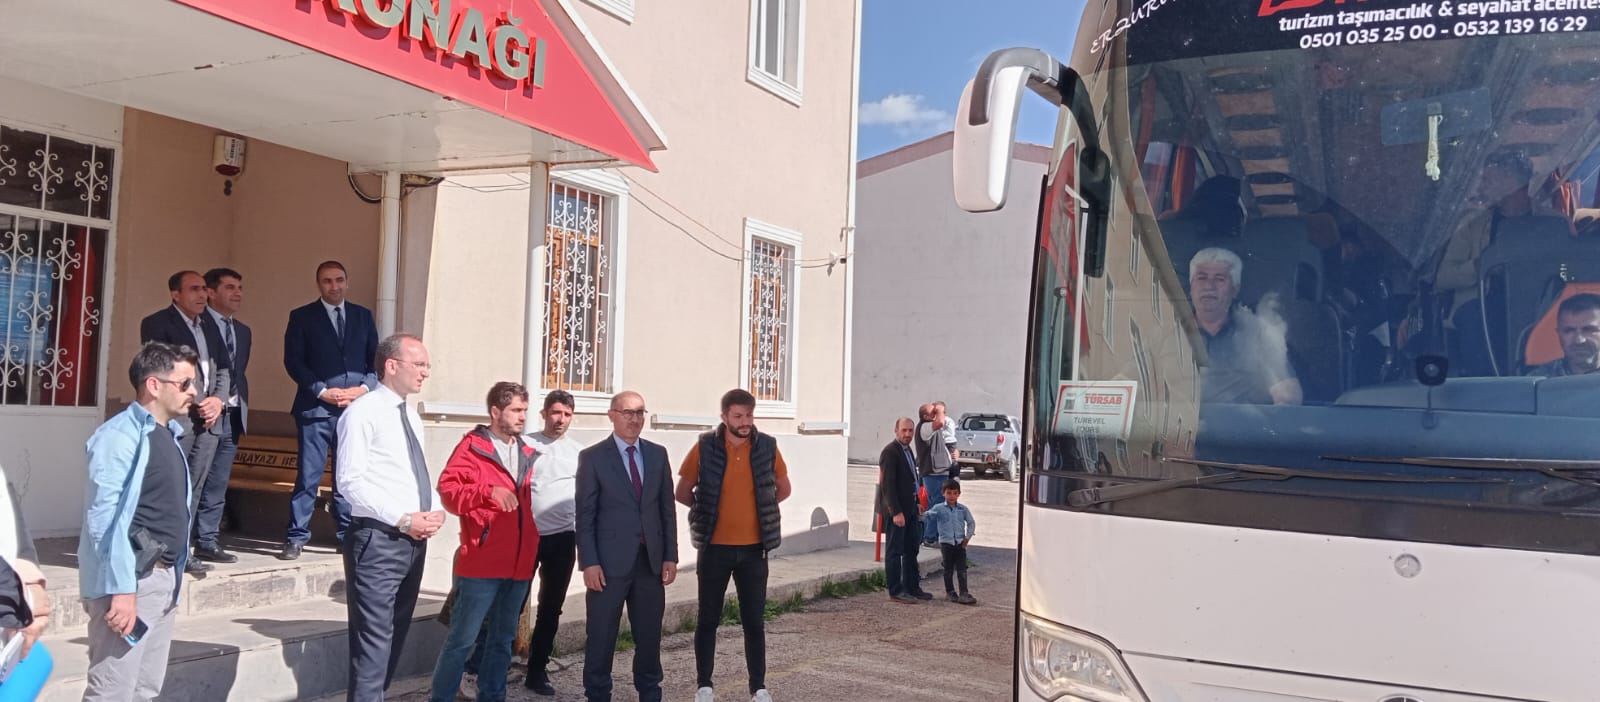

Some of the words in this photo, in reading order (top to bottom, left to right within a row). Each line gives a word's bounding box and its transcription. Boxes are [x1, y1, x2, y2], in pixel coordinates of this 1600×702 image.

[1090, 0, 1177, 53] ERZUR
[1278, 13, 1334, 31] turizm
[1337, 2, 1434, 27] taşımacılık
[1438, 1, 1453, 16] &
[1457, 0, 1531, 17] seyahat
[1534, 0, 1600, 11] acente
[338, 0, 547, 90] ONAĞI
[1300, 31, 1342, 49] 0501
[1346, 28, 1379, 44] 035
[1383, 26, 1405, 42] 25
[1409, 24, 1436, 39] 00
[1453, 20, 1499, 37] 0532
[1504, 18, 1534, 34] 139
[1539, 17, 1559, 32] 16
[1563, 16, 1588, 31] 29
[234, 452, 277, 465] ARAYAZI
